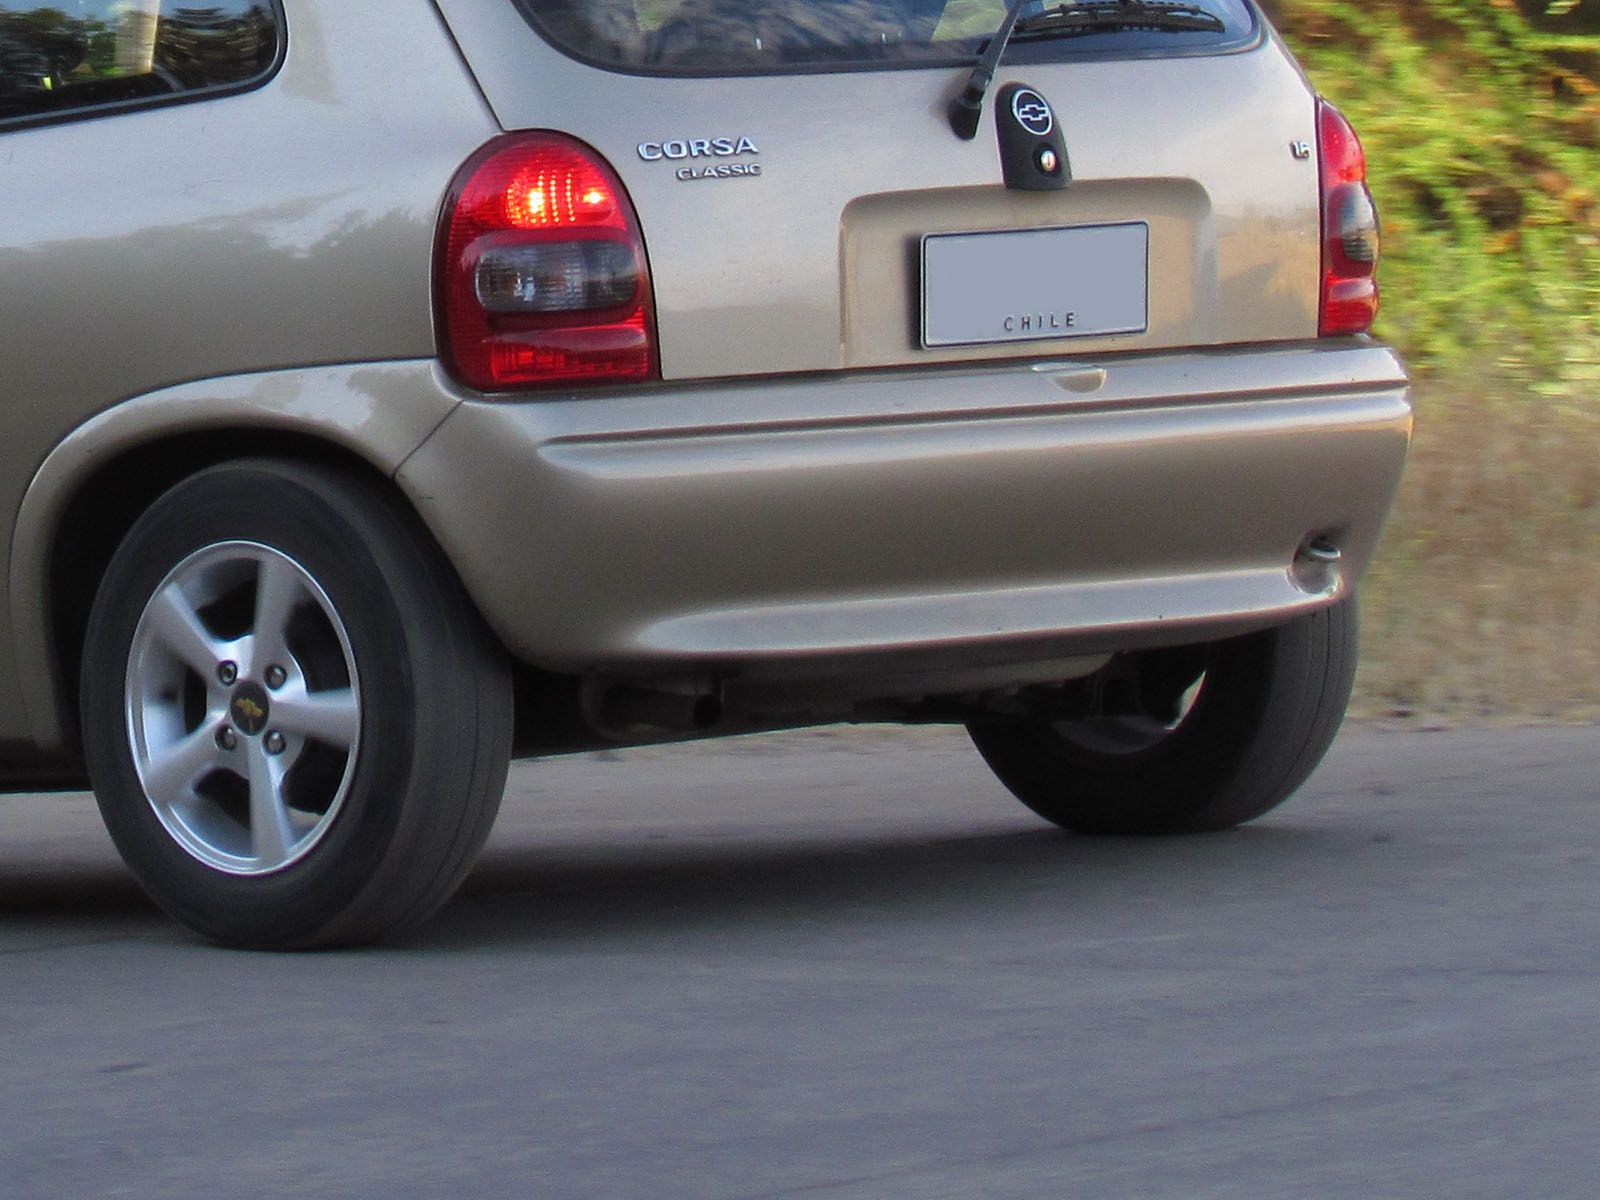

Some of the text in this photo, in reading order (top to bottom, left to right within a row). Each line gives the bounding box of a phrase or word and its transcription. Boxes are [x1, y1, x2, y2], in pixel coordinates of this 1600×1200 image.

[638, 135, 759, 161] CORSA
[676, 163, 762, 181] CLASSIC
[1003, 312, 1076, 332] CHILE
